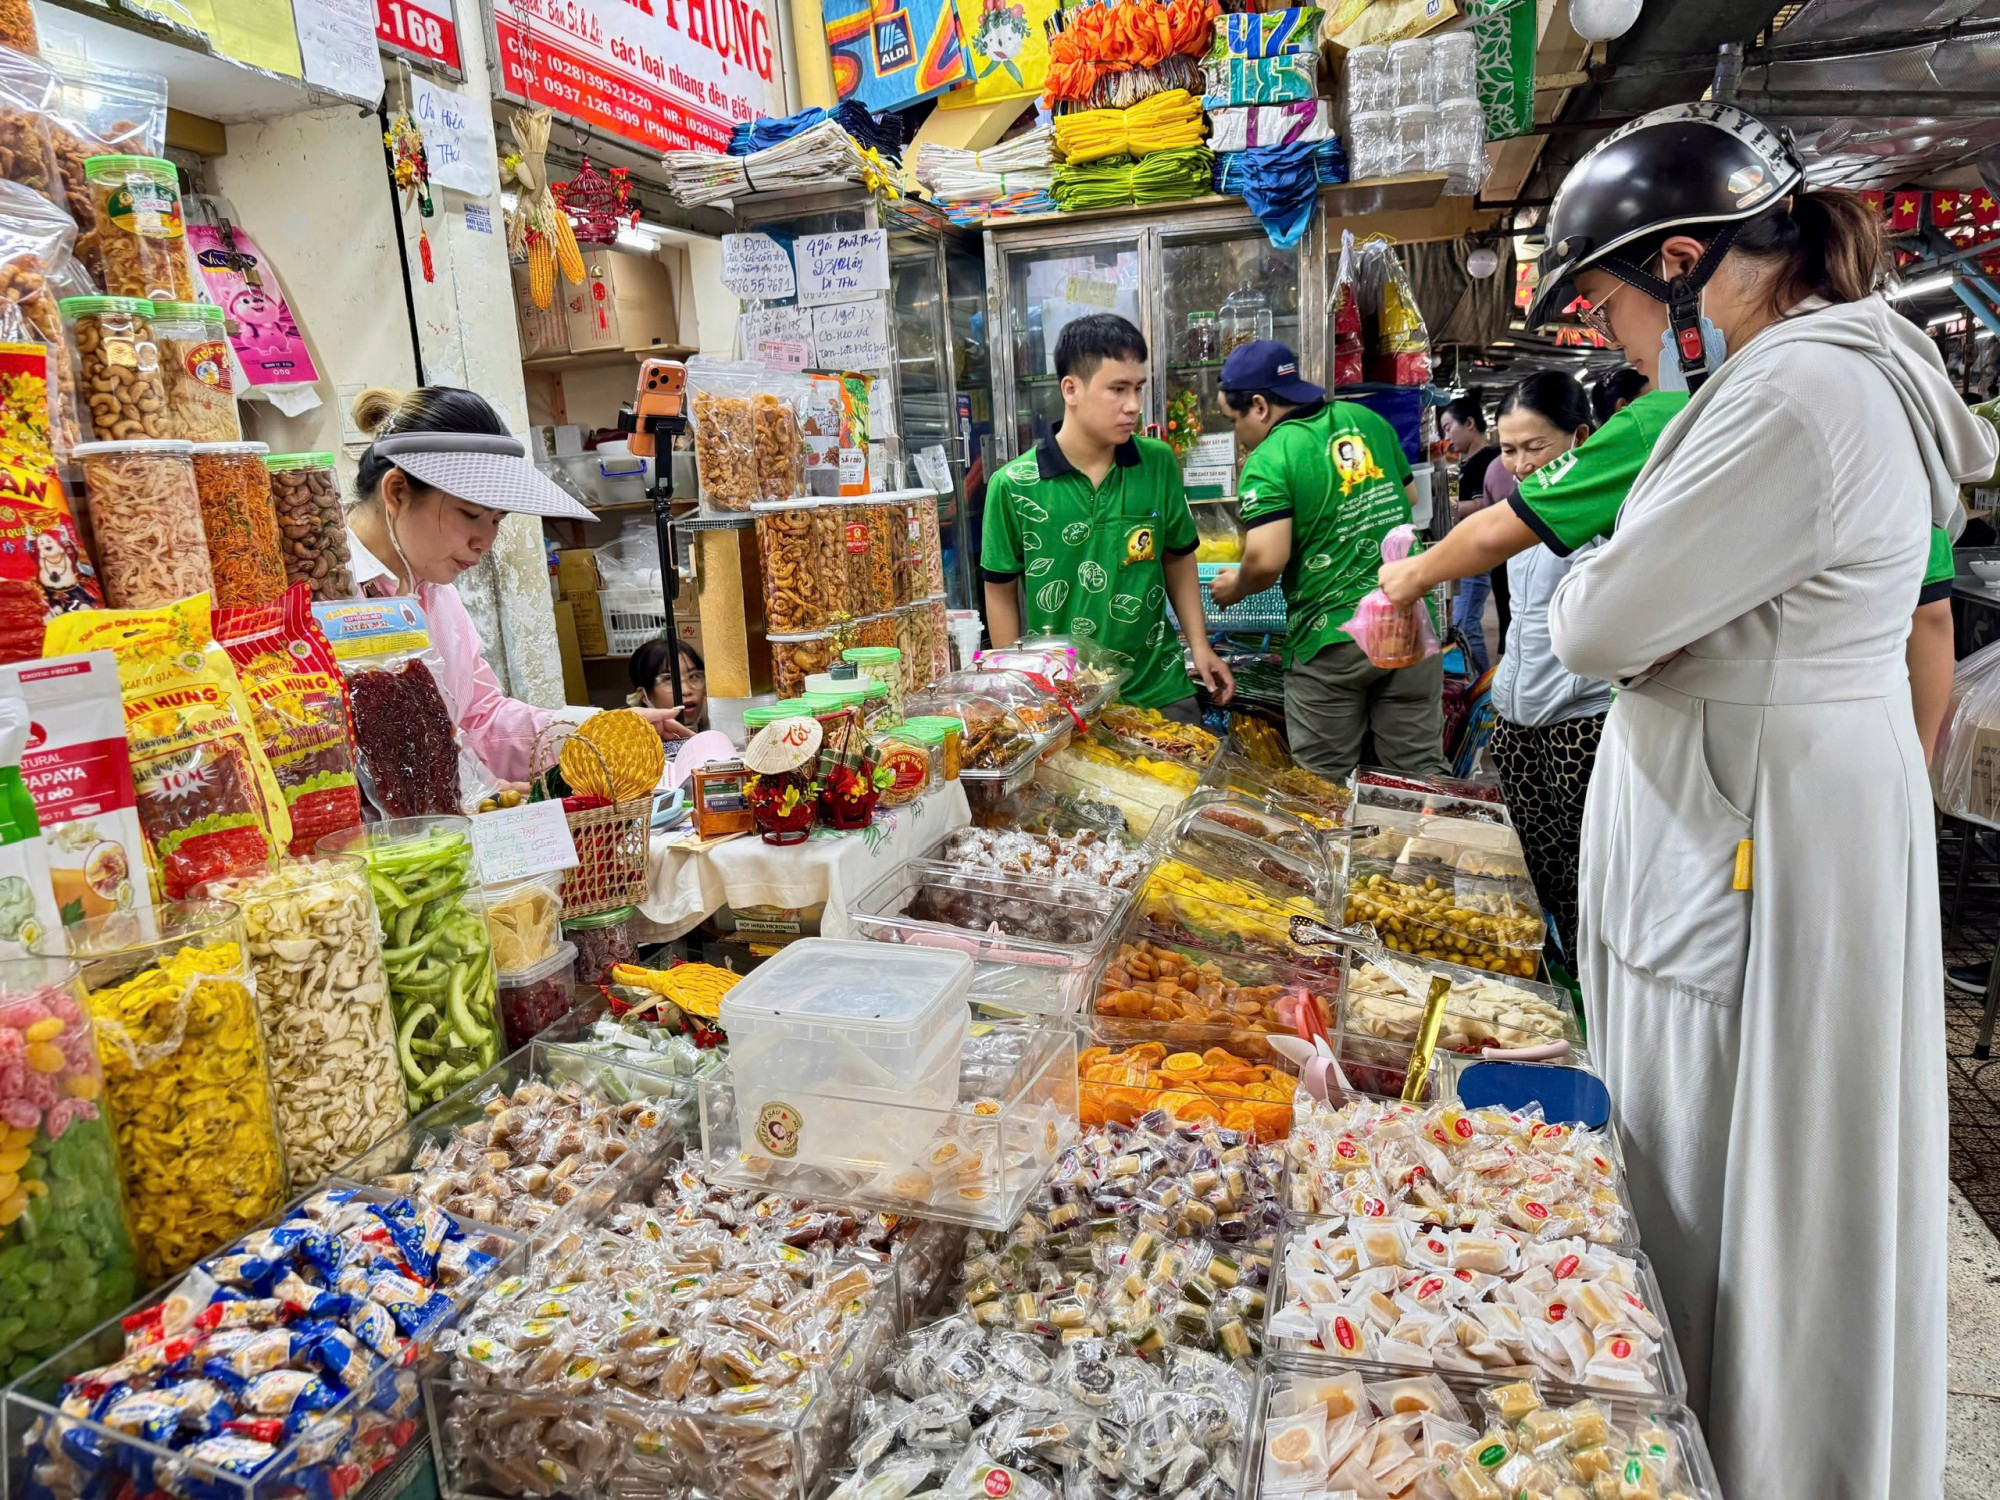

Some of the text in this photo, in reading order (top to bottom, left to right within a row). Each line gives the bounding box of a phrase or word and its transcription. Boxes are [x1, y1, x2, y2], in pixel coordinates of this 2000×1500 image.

[374, 0, 444, 55] .168
[610, 36, 636, 66] các
[639, 45, 665, 83] loại
[669, 63, 705, 104] nhang
[708, 81, 729, 112] đèn
[731, 95, 753, 122] giấy
[881, 45, 909, 66] ALDI
[544, 76, 640, 127] 0937.126.509
[643, 119, 691, 151] (PHỤNG)
[547, 54, 652, 112] (028)39521220
[663, 109, 683, 126] NR:
[20, 665, 79, 681] EXOTIC FRUITS
[20, 753, 64, 769] TURAL
